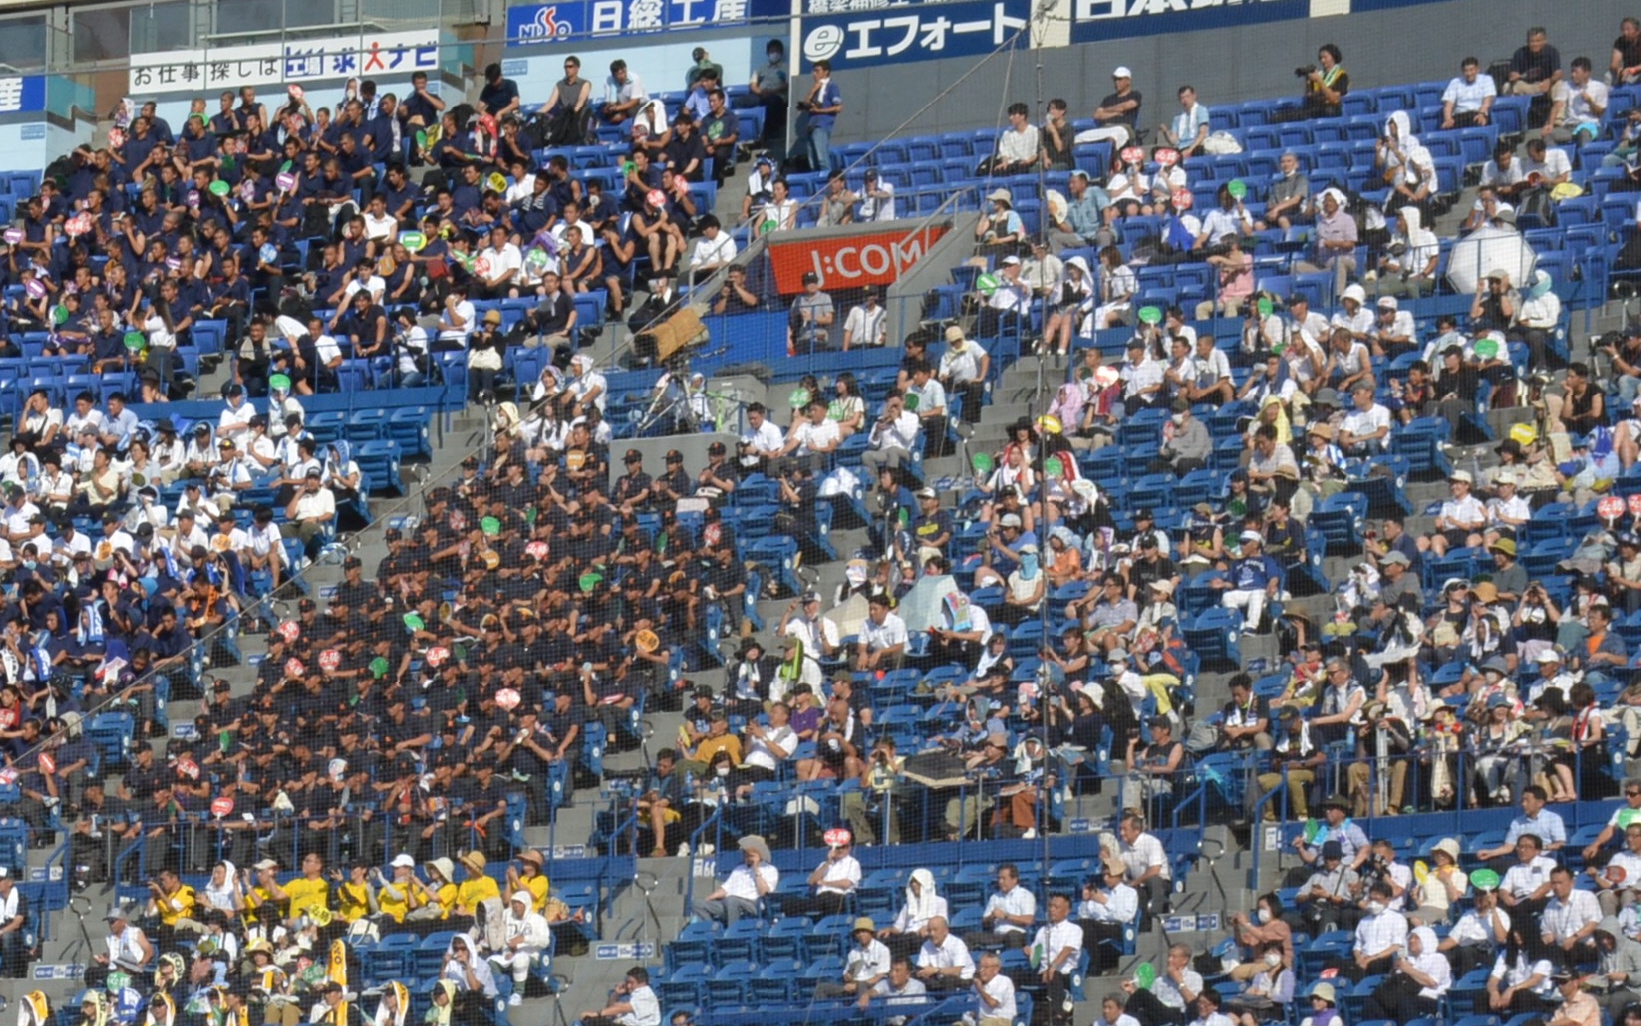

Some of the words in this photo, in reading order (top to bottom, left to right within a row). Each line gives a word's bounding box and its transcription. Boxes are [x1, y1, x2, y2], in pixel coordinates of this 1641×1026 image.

[846, 3, 1026, 59] エフォート
[134, 55, 278, 86] お仕事探しは
[812, 243, 923, 283] J:COM
